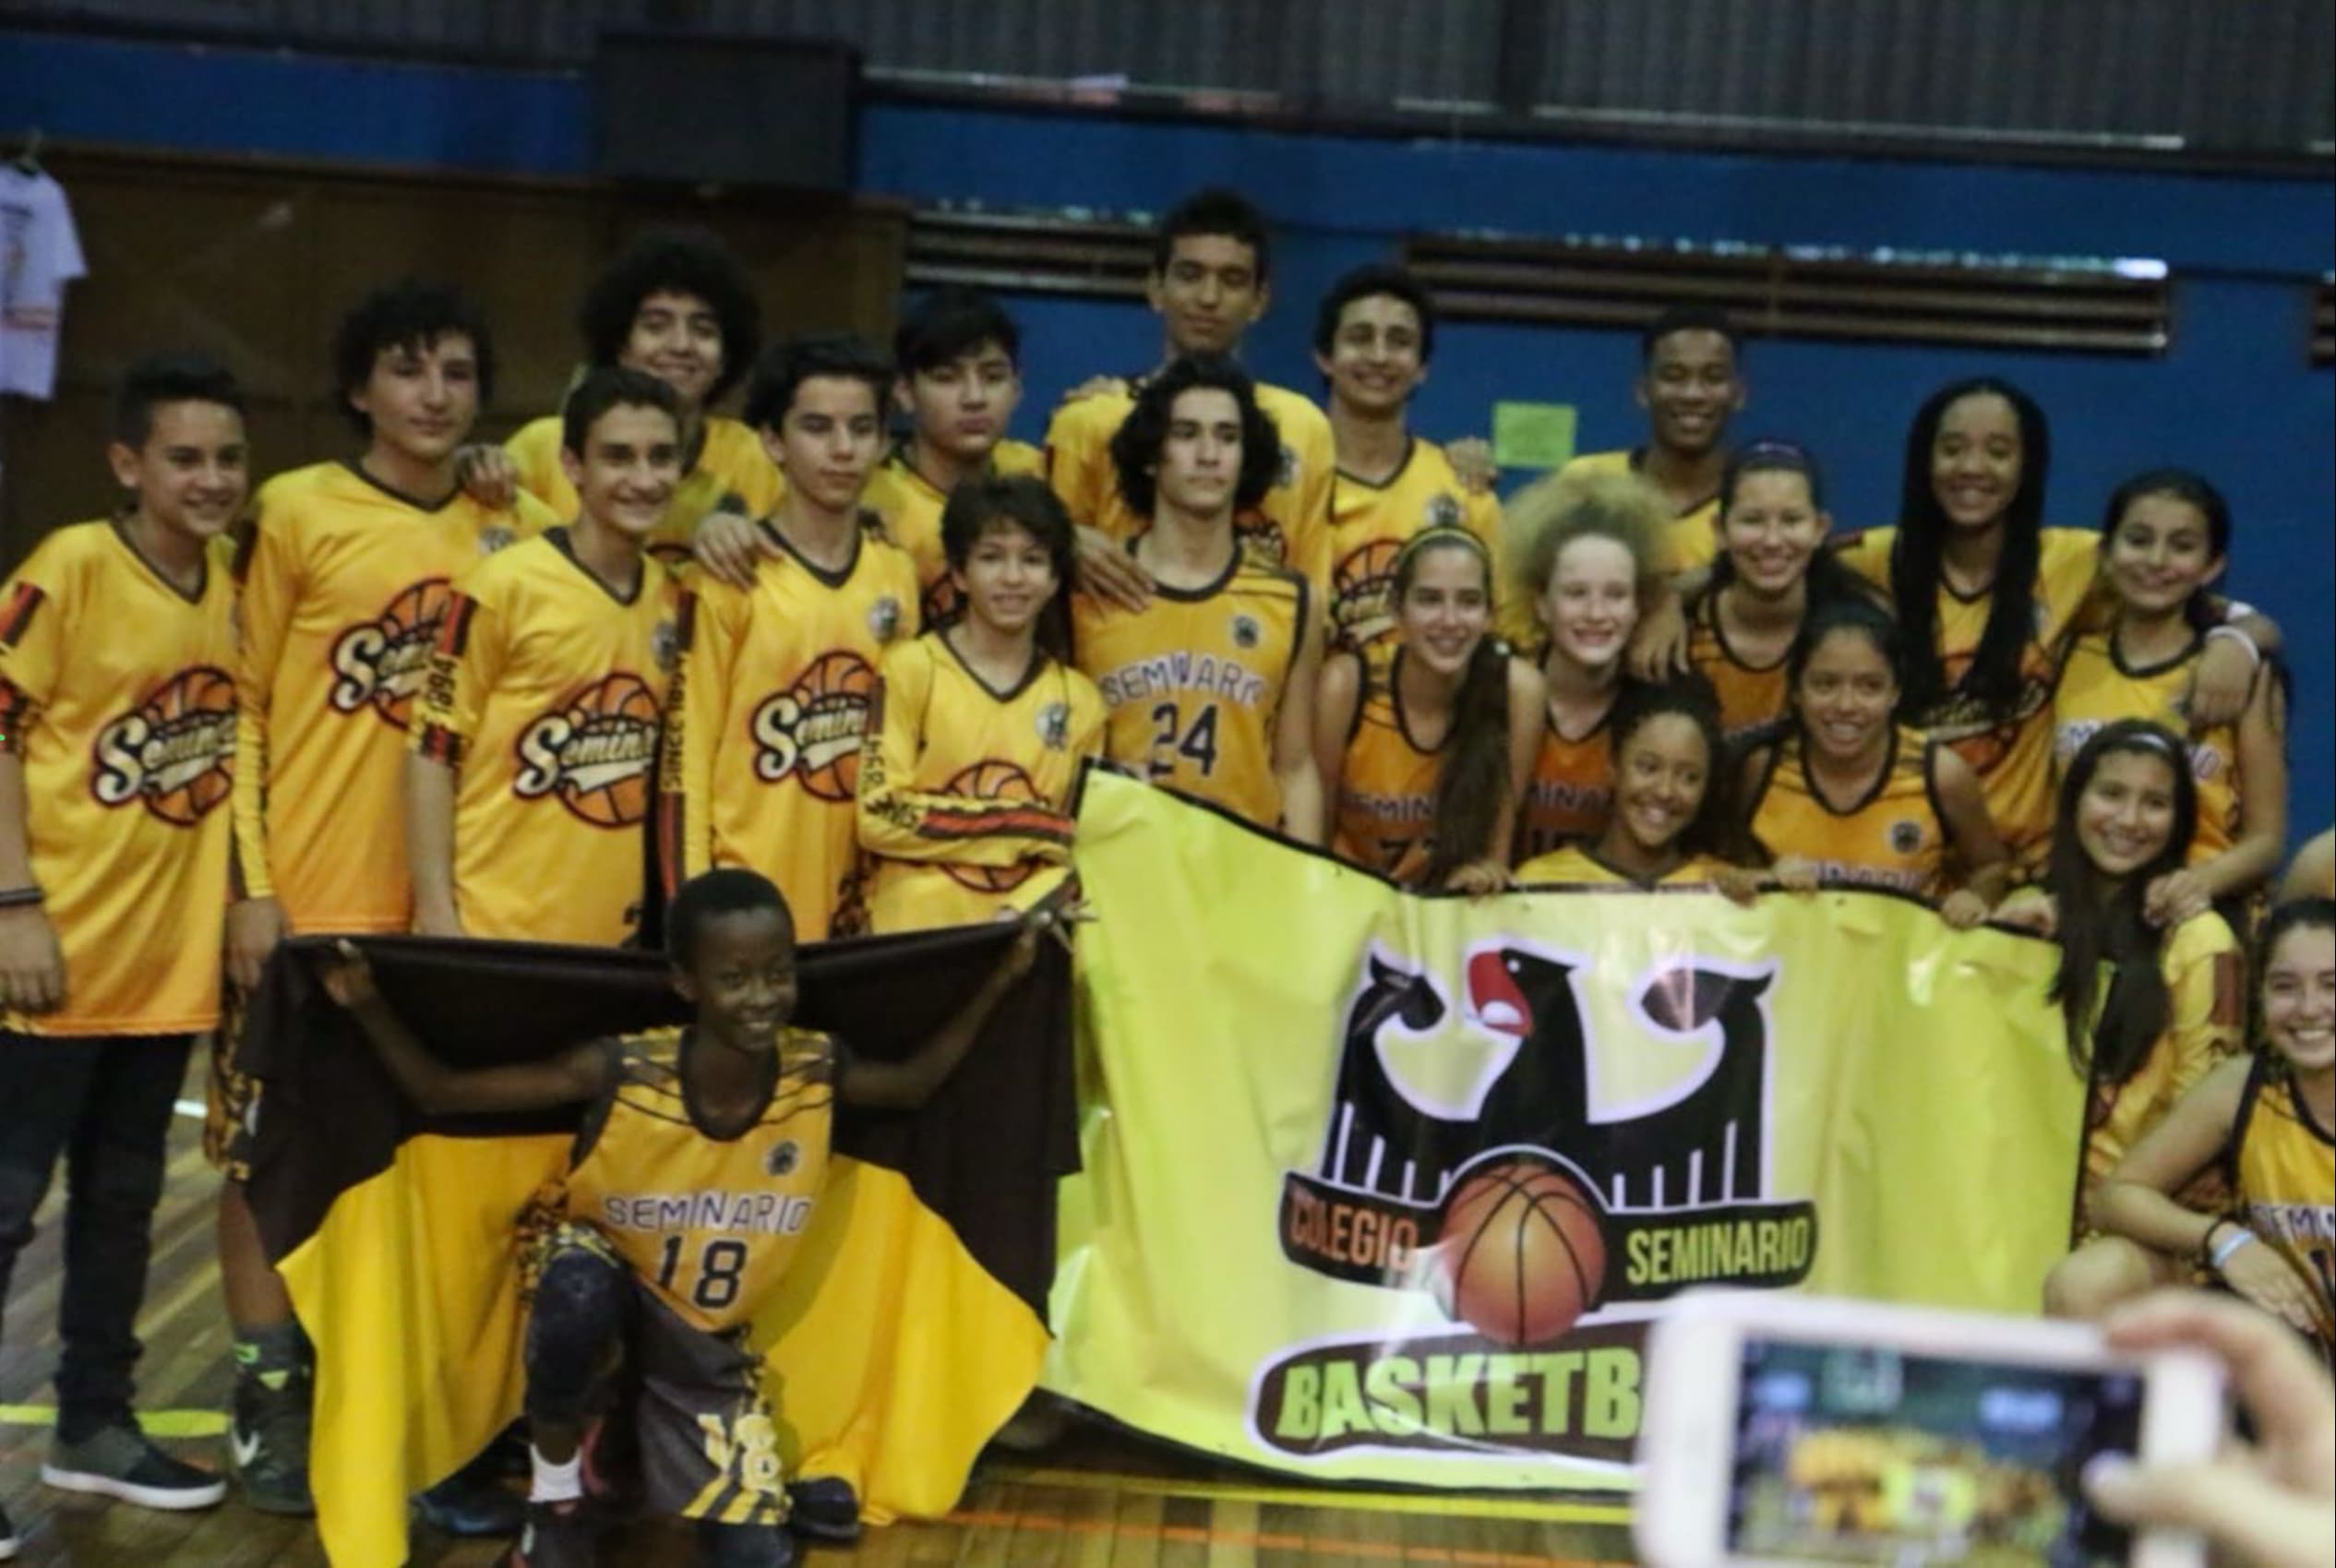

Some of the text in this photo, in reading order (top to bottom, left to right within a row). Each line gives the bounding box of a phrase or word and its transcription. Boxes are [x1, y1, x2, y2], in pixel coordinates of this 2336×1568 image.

[1149, 701, 1218, 777] 24
[605, 1192, 813, 1235] SEMINARIO
[1291, 1194, 1809, 1286] COLEGIO SEMINARIO
[659, 1234, 748, 1309] 18
[1275, 1347, 1641, 1440] BASKETB
